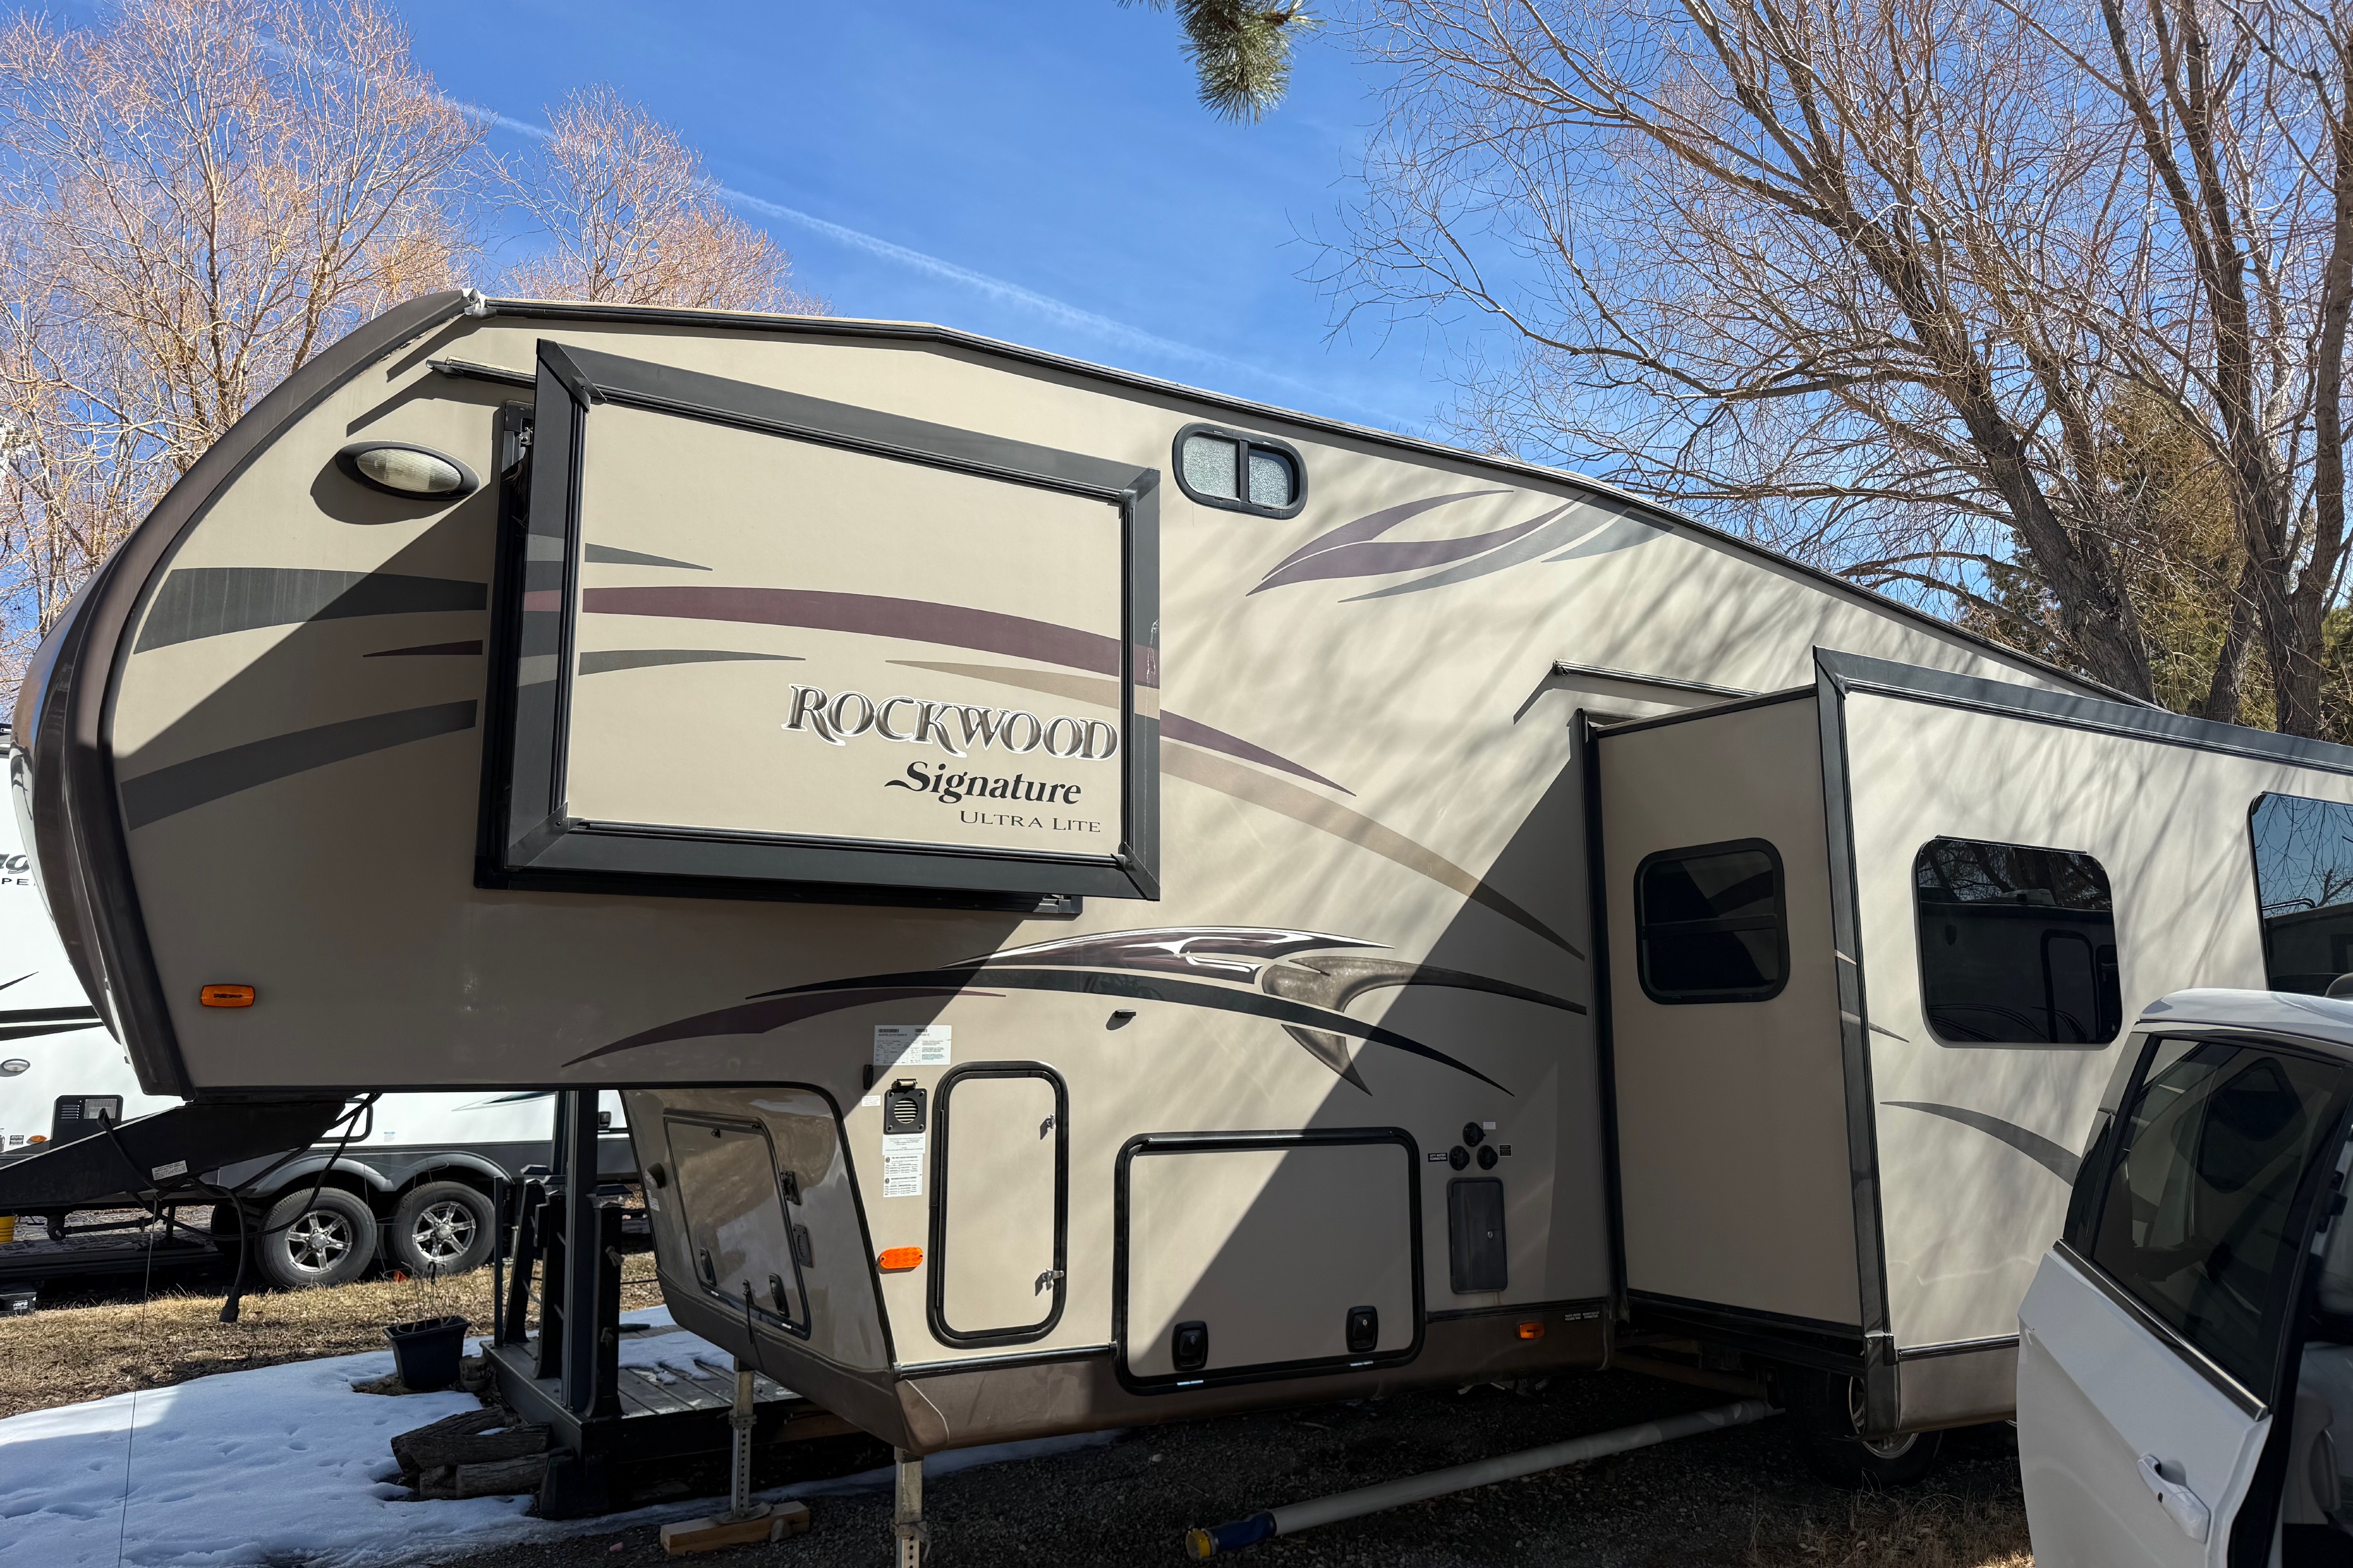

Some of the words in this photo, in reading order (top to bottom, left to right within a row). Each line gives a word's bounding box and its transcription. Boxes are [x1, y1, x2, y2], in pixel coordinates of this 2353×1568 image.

[781, 684, 1119, 761] ROCKWOOD
[884, 761, 1081, 804] Signature
[960, 810, 1043, 828] ULTRA
[1052, 818, 1101, 833] LITE
